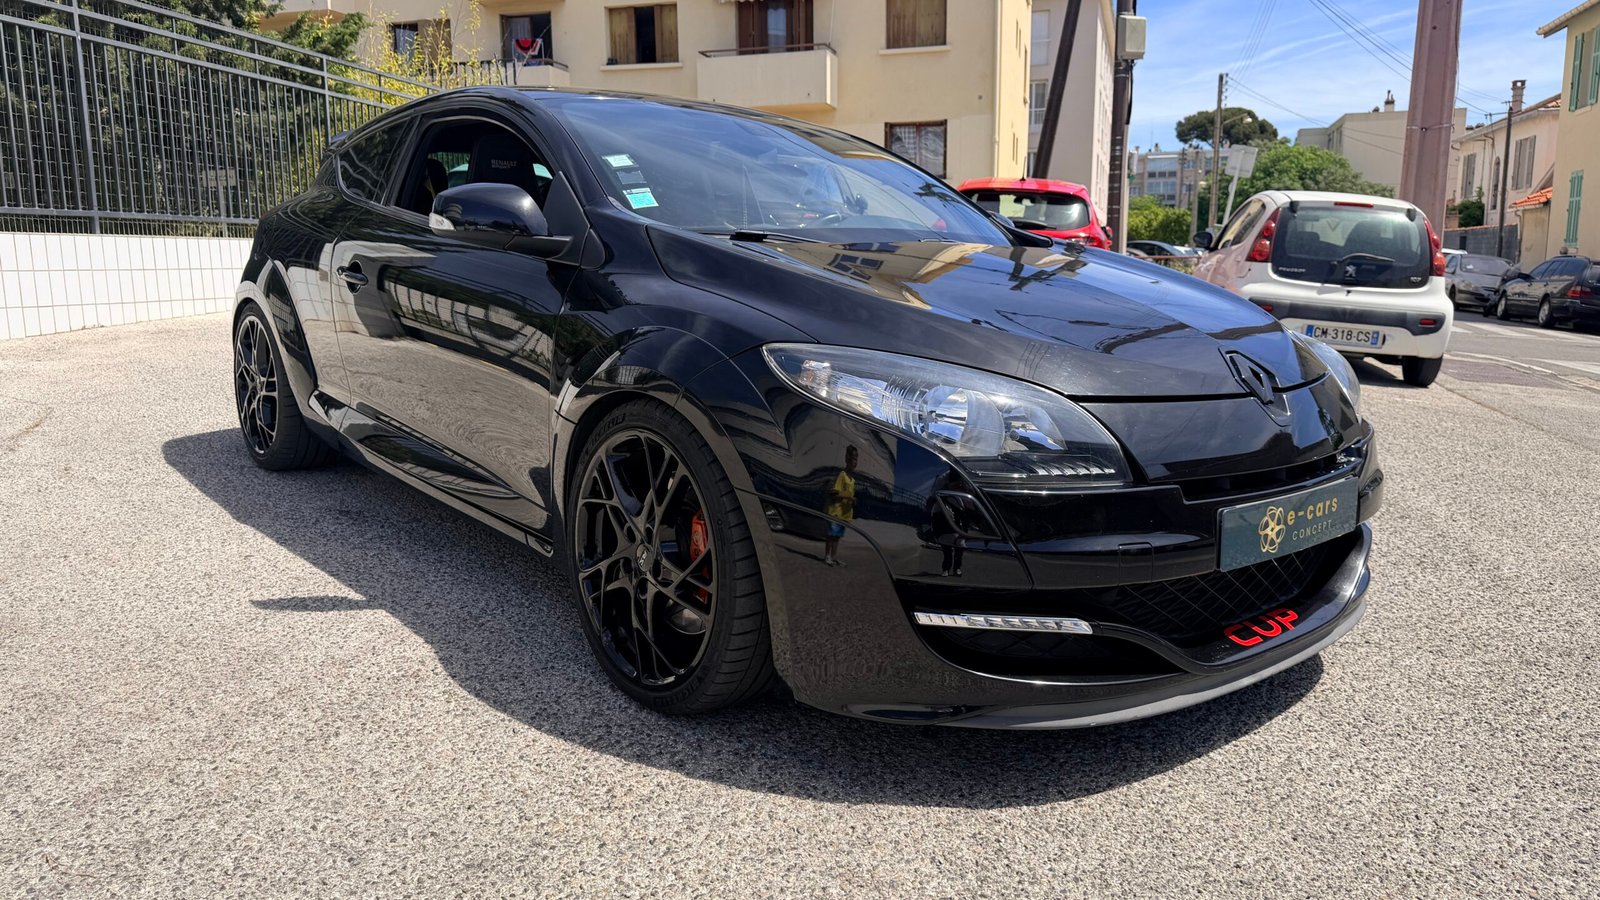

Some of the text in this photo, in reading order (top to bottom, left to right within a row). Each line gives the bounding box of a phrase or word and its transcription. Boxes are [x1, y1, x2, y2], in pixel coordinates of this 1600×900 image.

[1313, 326, 1371, 342] CM-318-CS
[1287, 496, 1338, 526] e-cars
[1292, 519, 1333, 541] CONCEPT
[1223, 607, 1299, 647] CUP
